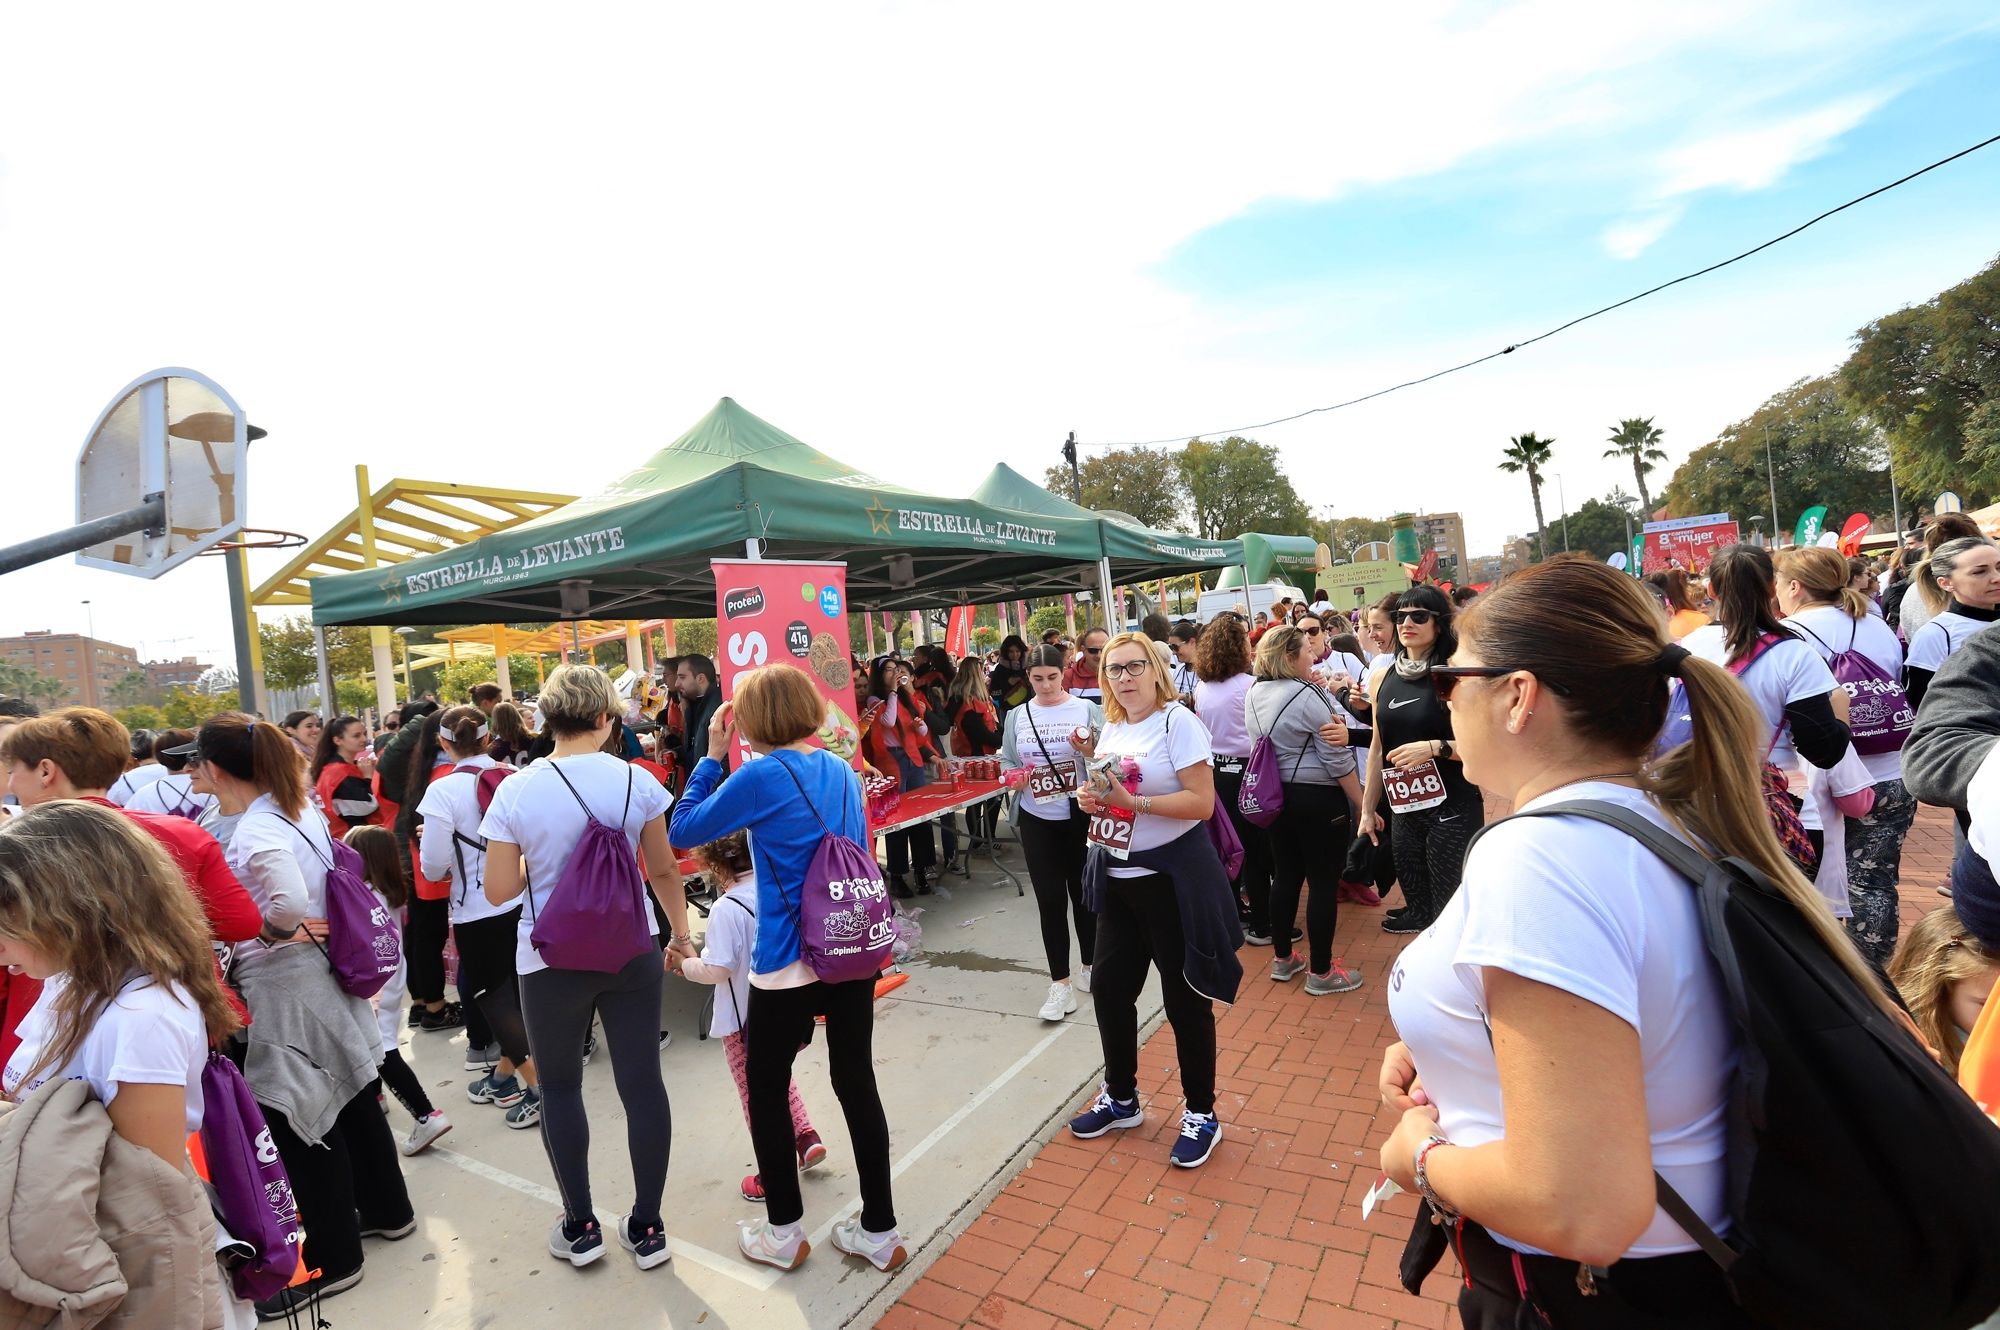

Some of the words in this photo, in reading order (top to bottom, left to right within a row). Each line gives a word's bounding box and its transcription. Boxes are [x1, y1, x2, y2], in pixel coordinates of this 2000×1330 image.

[898, 509, 985, 536] ESTRELLA
[985, 524, 996, 533] DE
[996, 521, 1057, 546] LEVANTE
[1679, 531, 1713, 545] mujer
[406, 555, 504, 595] ESTRELLA
[506, 556, 521, 570] DE
[520, 526, 625, 570] LEVANTE
[483, 574, 511, 586] MURCIA
[511, 571, 530, 580] 1963
[1347, 568, 1387, 577] LIMONES
[1347, 574, 1381, 582] MURCIA
[728, 594, 761, 612] Protein
[822, 591, 838, 603] 14g
[790, 632, 808, 647] 41g
[1408, 762, 1432, 773] MURCIA
[1031, 772, 1075, 794] 3697
[1388, 775, 1440, 800] 1948
[824, 946, 862, 956] LaOpinión
